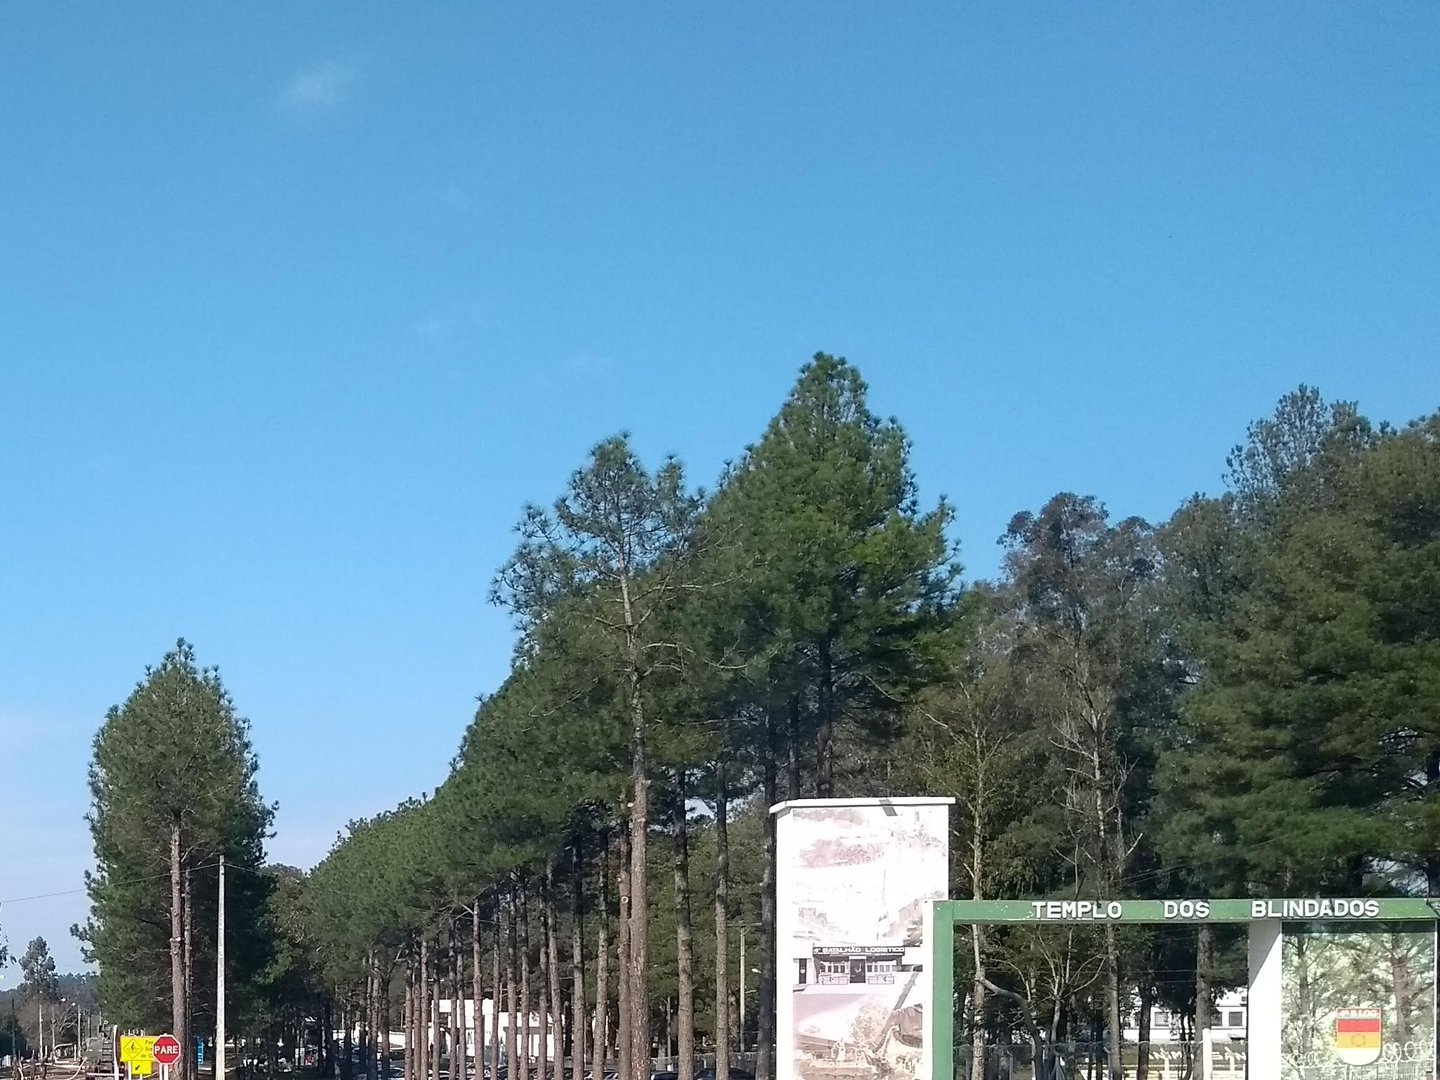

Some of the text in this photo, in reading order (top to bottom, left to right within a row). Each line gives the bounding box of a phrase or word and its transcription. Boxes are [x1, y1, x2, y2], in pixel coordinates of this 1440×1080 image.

[1032, 899, 1380, 919] TEMPLO DOS BLINDADOS
[154, 1045, 178, 1054] PARE
